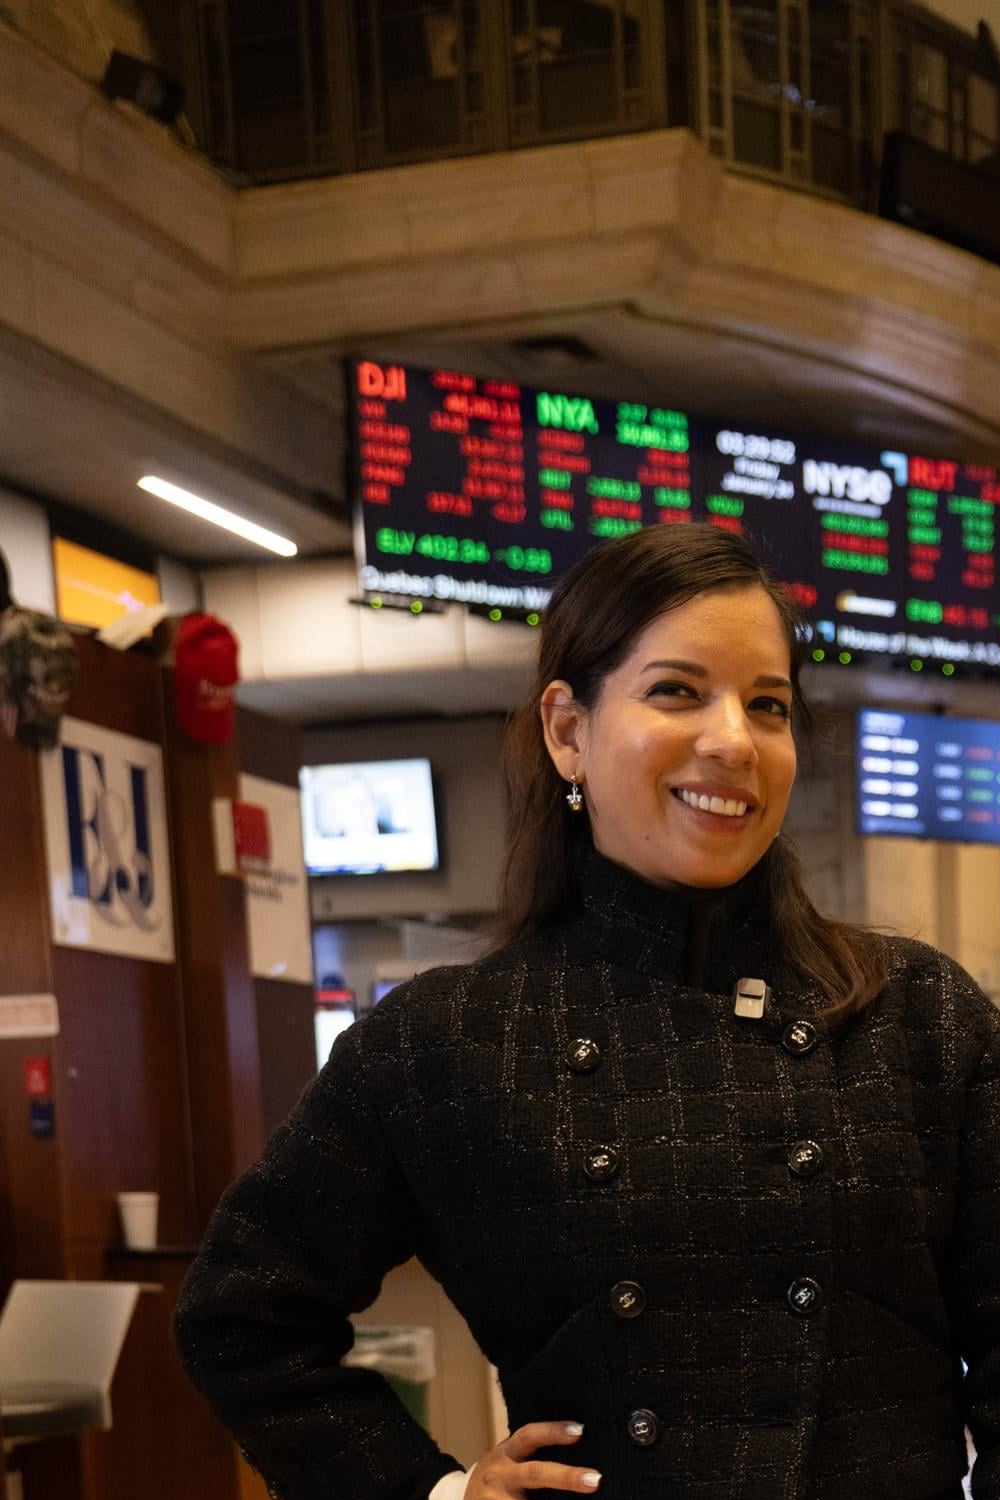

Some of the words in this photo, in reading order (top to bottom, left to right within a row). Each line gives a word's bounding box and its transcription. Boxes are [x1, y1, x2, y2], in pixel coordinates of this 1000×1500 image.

[356, 361, 408, 401] DJI
[536, 391, 600, 435] NYA
[375, 526, 416, 556] ELV
